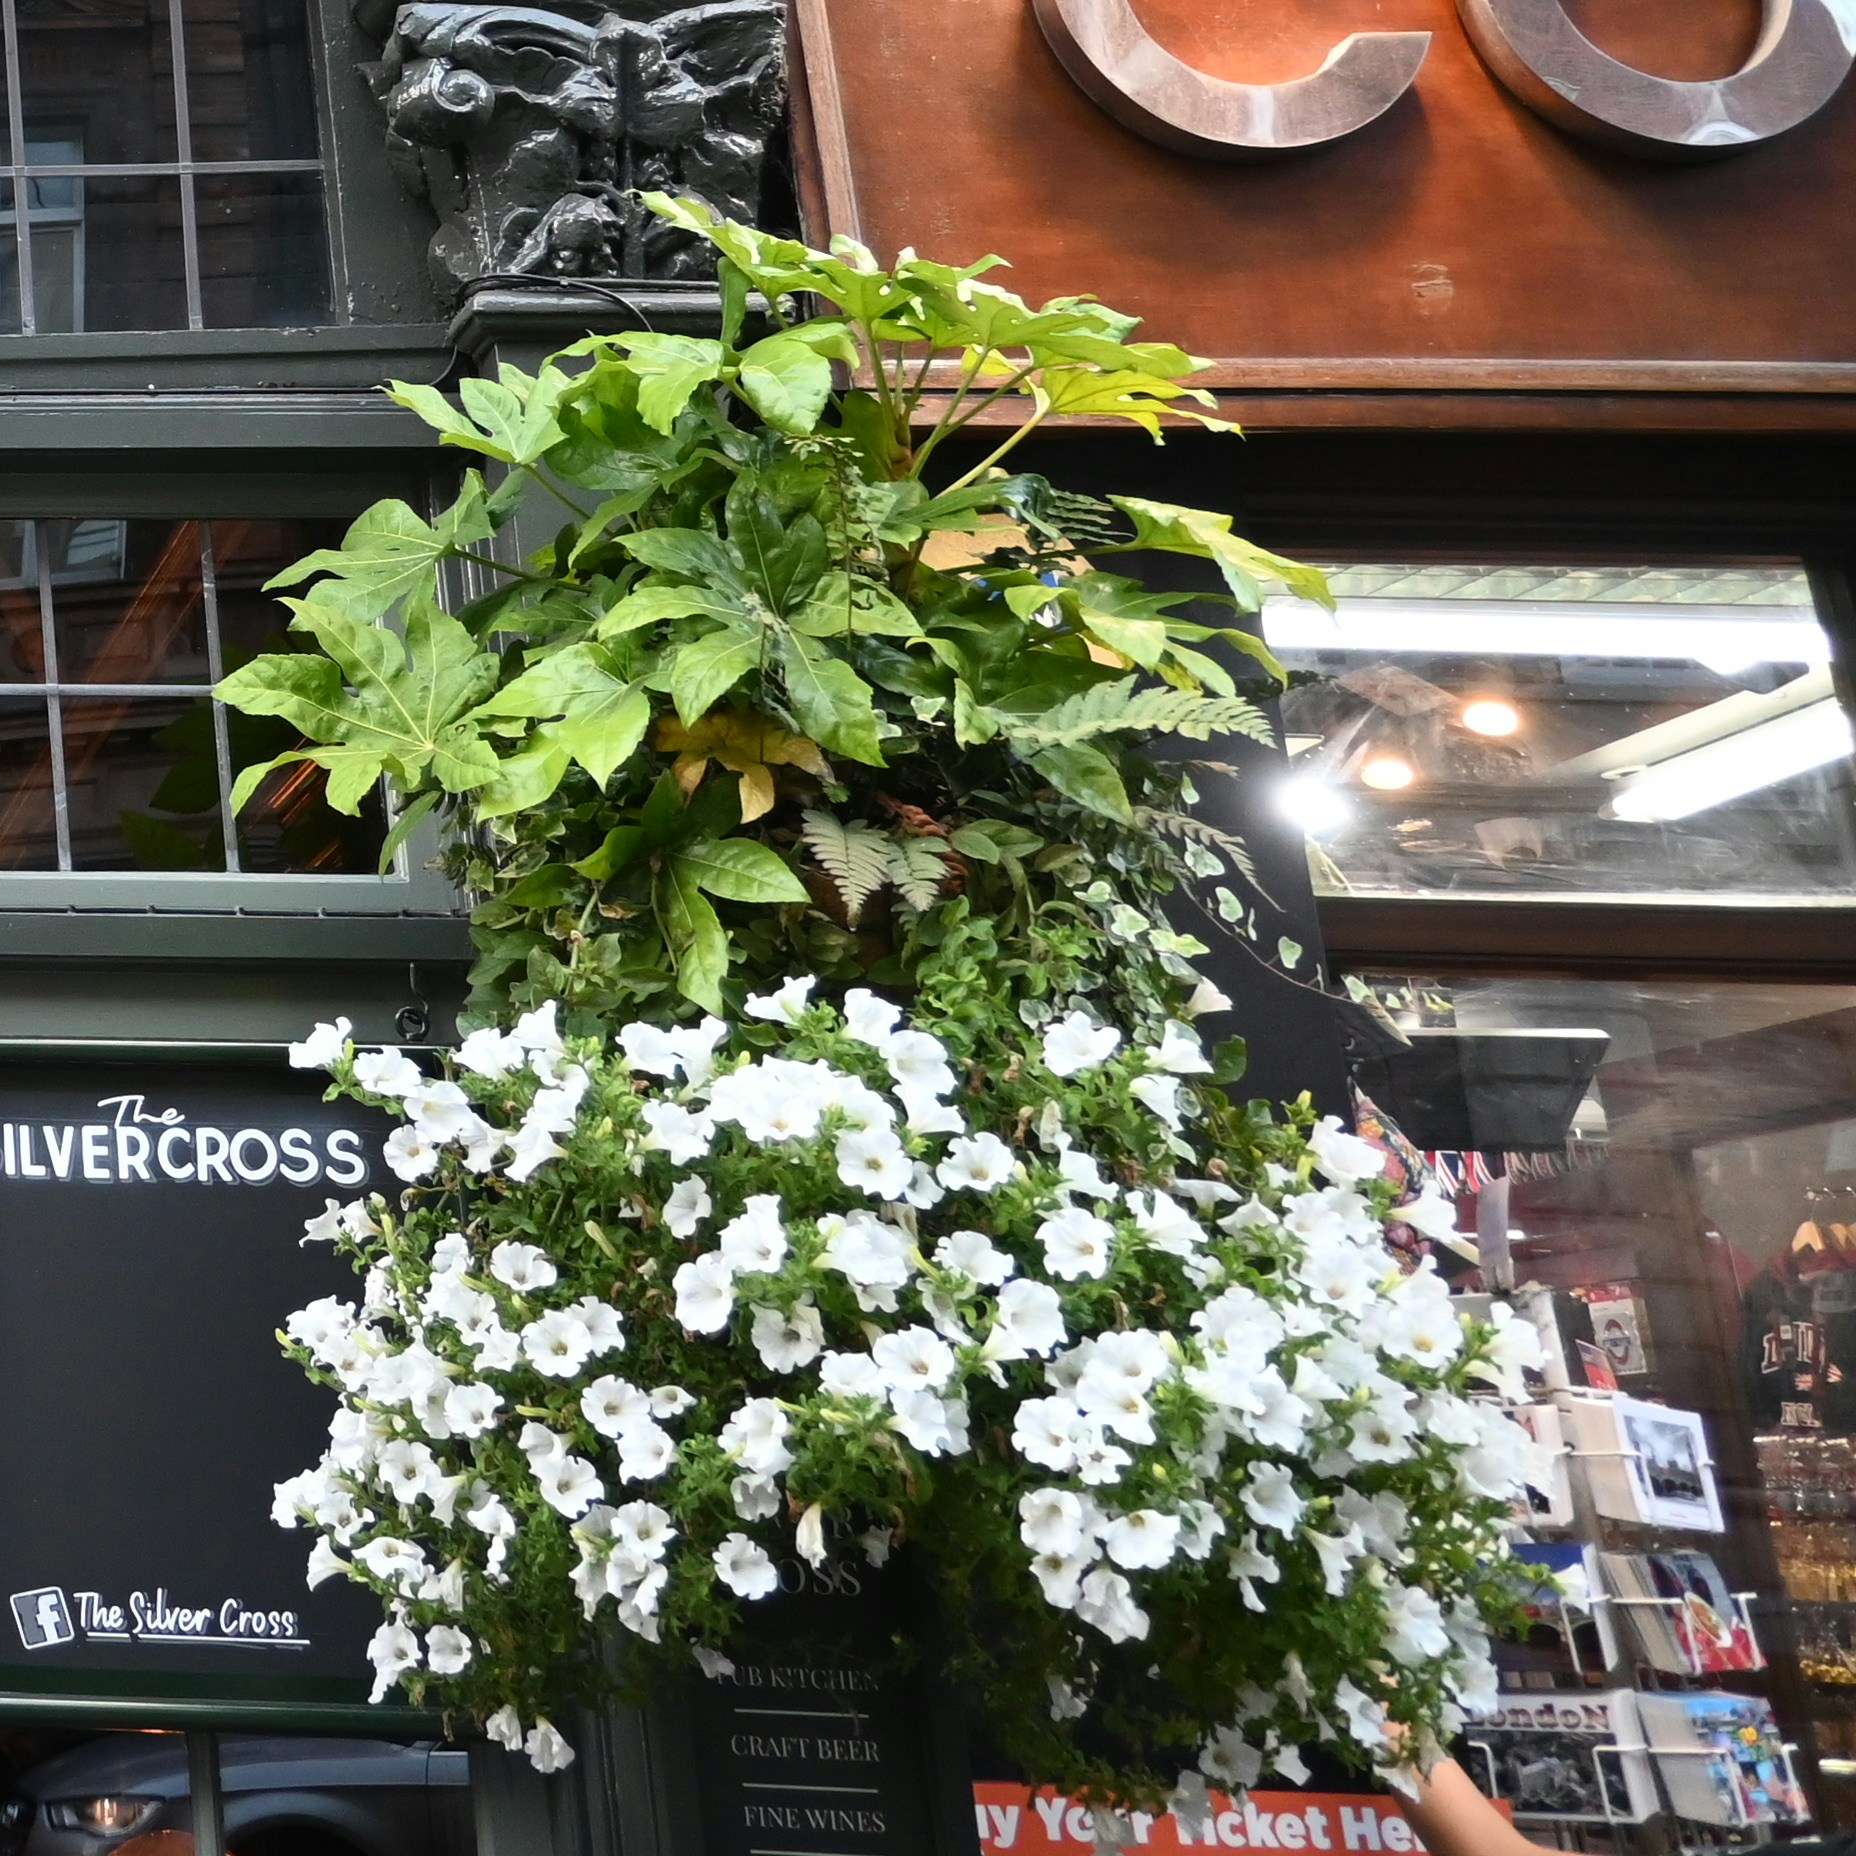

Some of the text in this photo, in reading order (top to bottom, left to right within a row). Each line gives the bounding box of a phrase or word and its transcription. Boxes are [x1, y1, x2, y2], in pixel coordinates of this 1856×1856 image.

[97, 1094, 186, 1129] The
[73, 1591, 124, 1629] The
[129, 1587, 212, 1635] Silver
[219, 1597, 294, 1637] Cross
[730, 1734, 880, 1762] CRAFT BEER
[743, 1805, 887, 1833] FINE WINES
